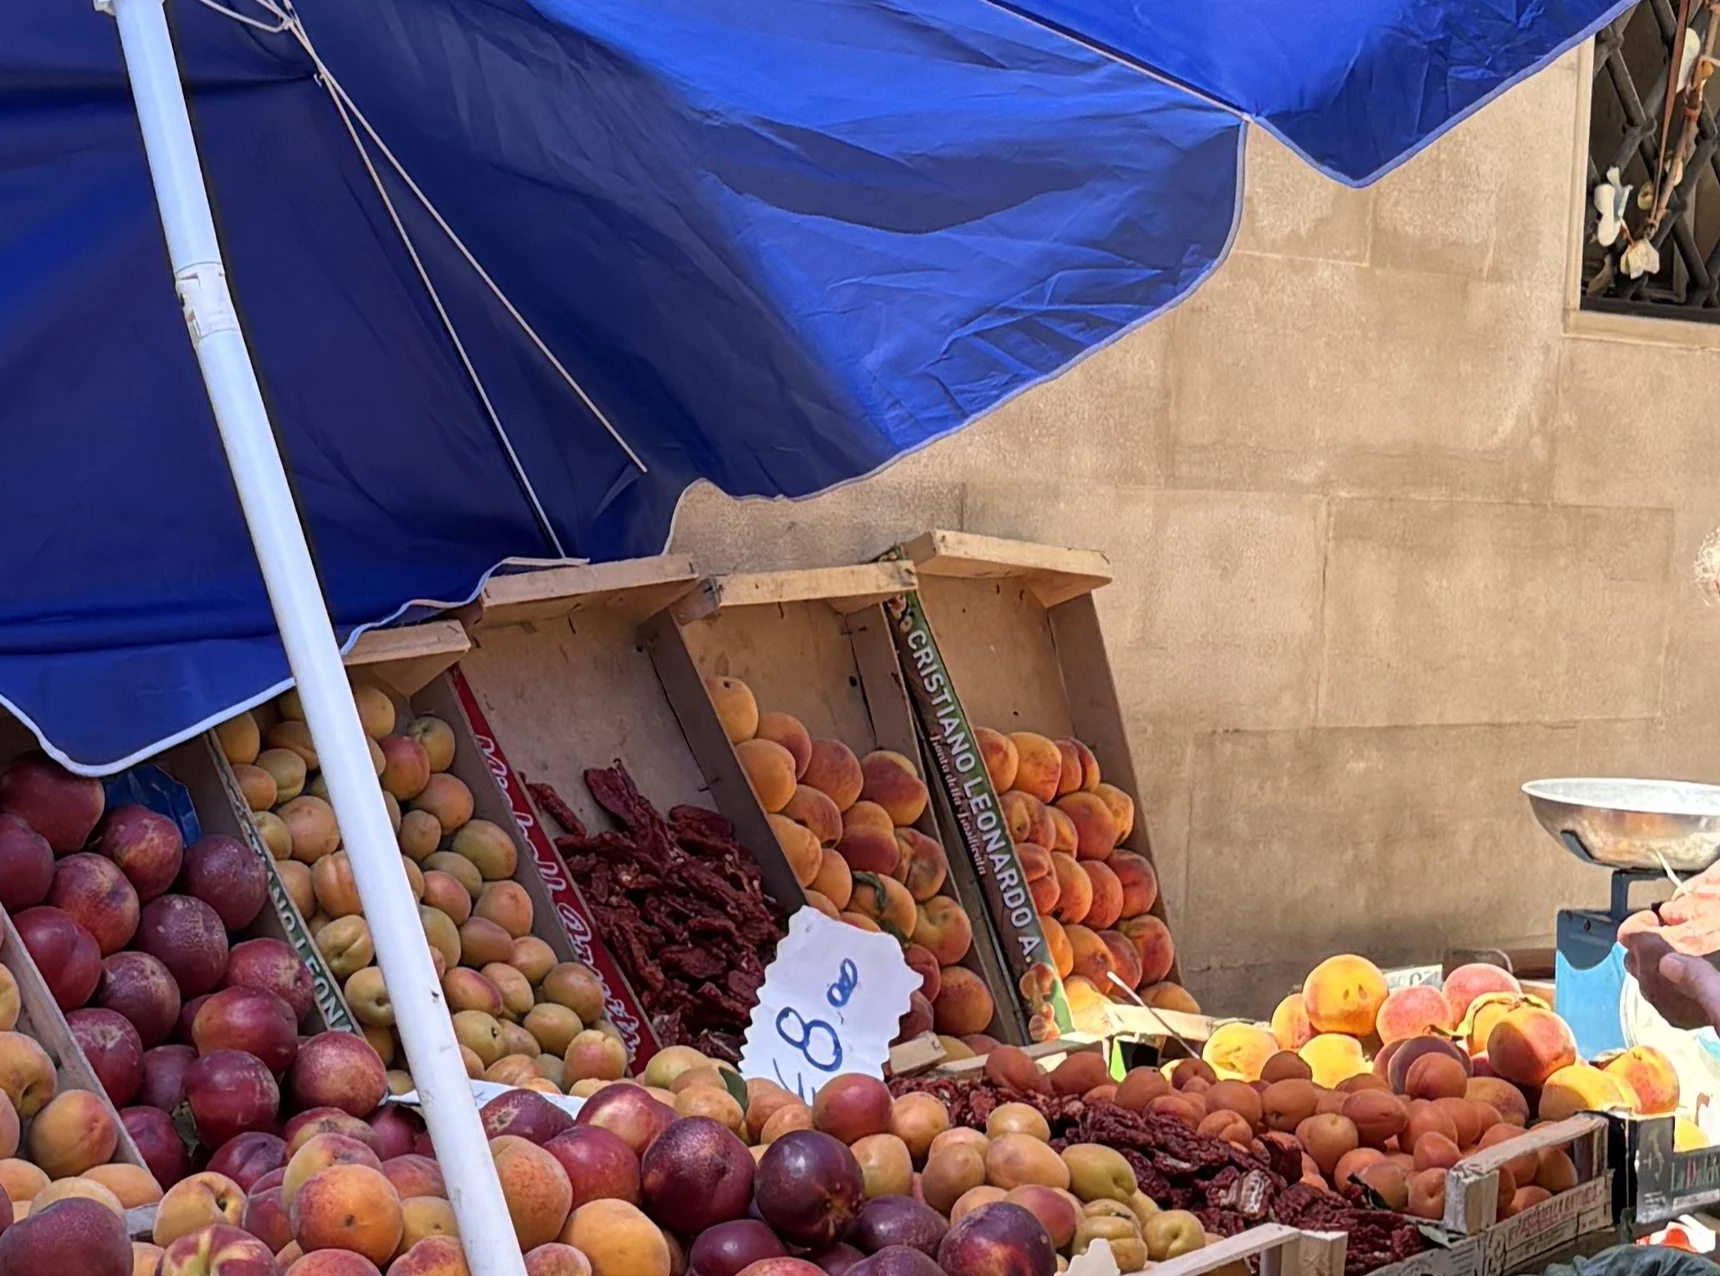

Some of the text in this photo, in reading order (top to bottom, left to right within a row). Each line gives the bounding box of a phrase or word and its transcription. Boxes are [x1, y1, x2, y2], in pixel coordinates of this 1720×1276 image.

[907, 629, 1041, 964] CRISTIANO LEONARDO A.
